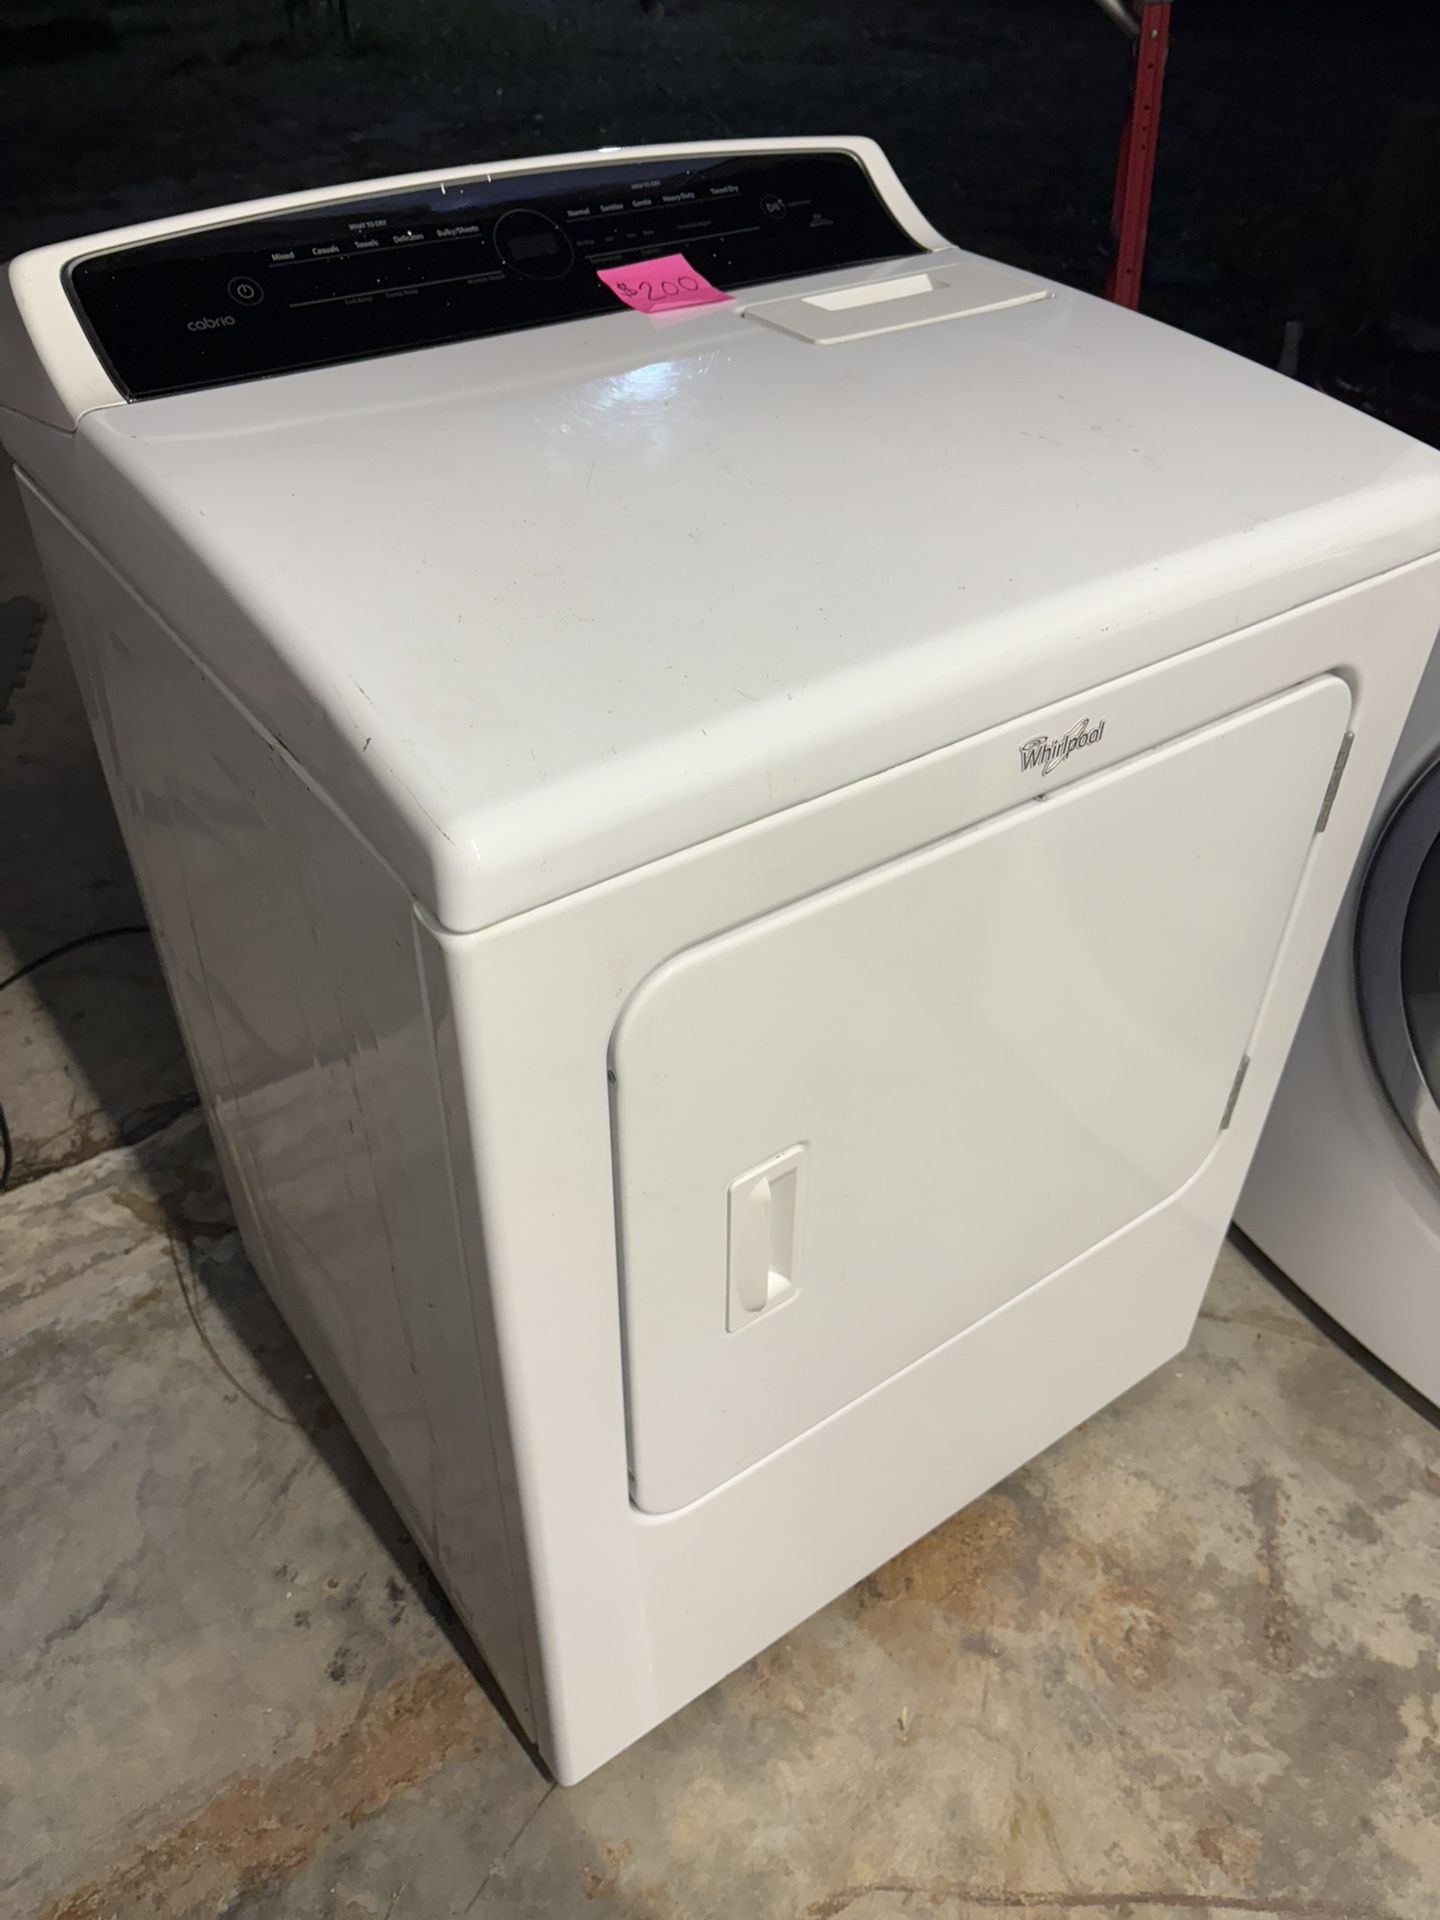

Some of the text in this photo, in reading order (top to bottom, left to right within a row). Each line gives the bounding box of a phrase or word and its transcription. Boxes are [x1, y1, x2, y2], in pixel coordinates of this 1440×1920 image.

[567, 207, 590, 217] Normal
[632, 199, 652, 208] Gentle
[662, 193, 681, 203] Heavy
[680, 191, 695, 201] Duty
[727, 185, 739, 194] Dry
[271, 225, 480, 262] Mixed Casuals Towels Delicates Bulky/Sheets
[616, 275, 699, 302] $200
[186, 316, 236, 332] cabrio
[1020, 719, 1105, 773] Whirlpool
